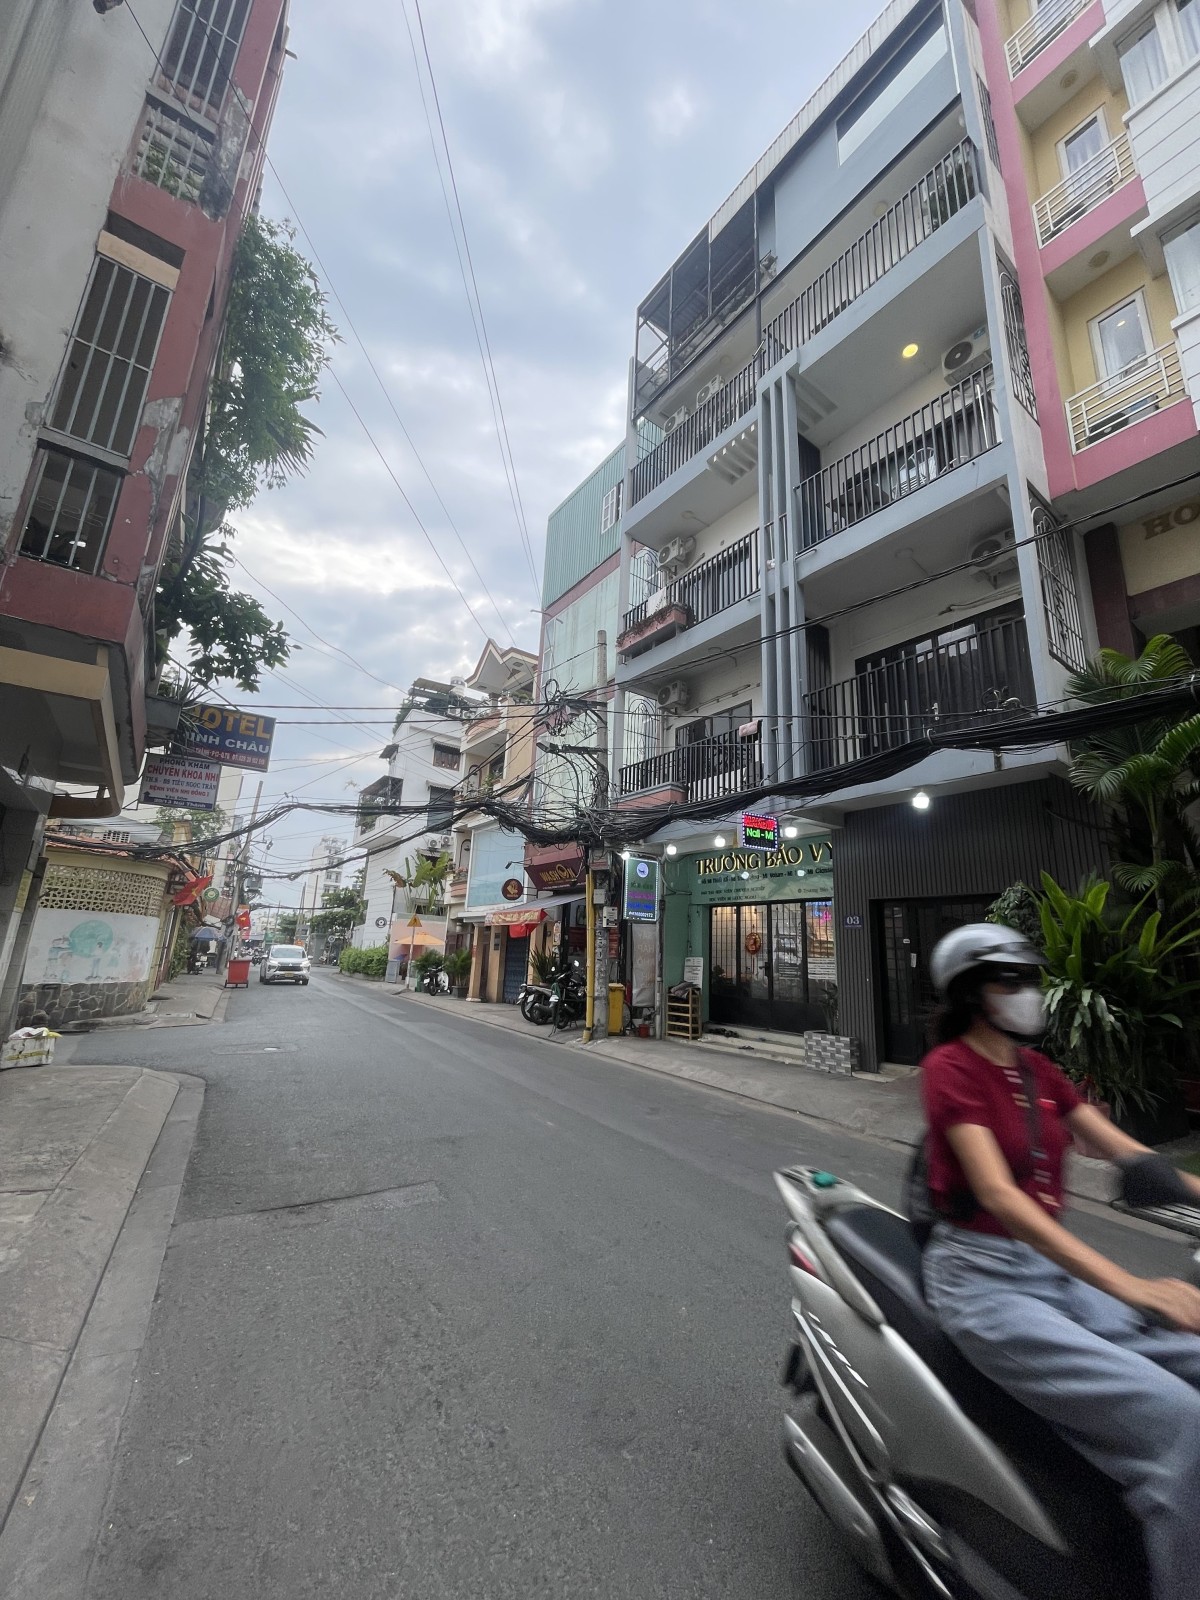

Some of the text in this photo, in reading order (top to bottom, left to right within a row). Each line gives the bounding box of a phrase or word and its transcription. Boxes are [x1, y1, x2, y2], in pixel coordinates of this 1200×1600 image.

[147, 764, 219, 782] CHUYÊN KHOA NHI
[696, 852, 761, 875] TRƯƠNG
[846, 915, 861, 925] 03
